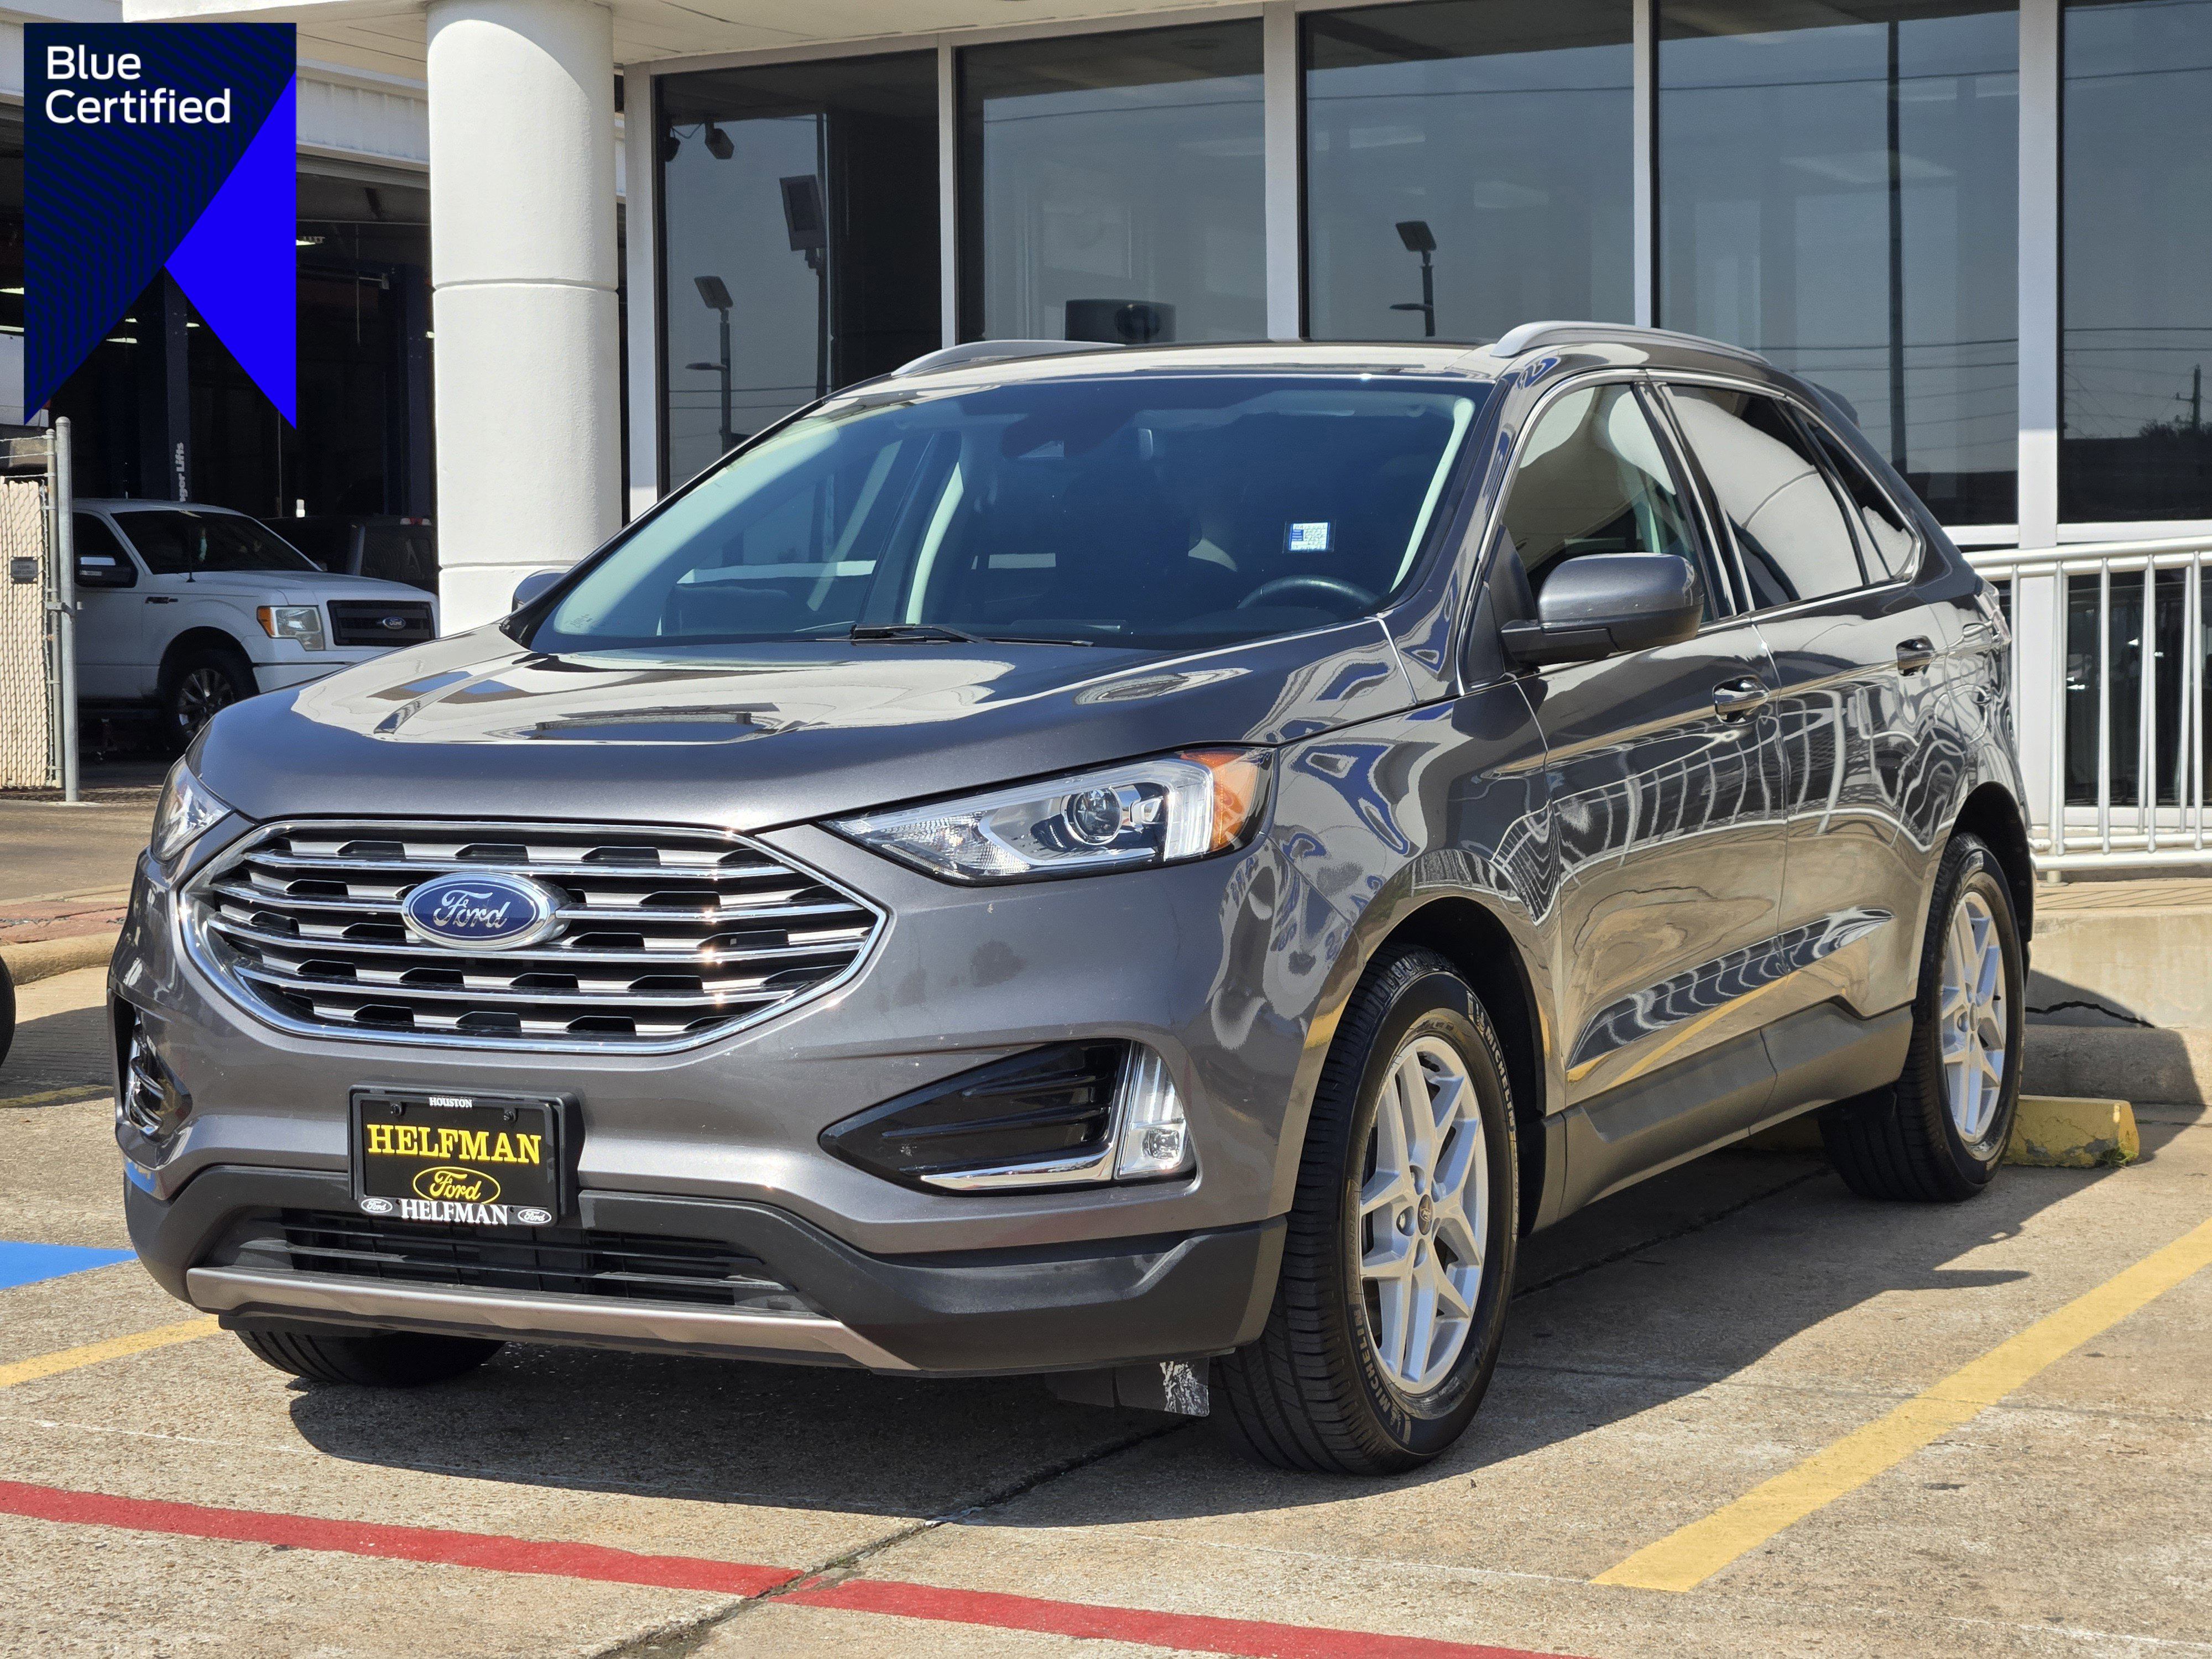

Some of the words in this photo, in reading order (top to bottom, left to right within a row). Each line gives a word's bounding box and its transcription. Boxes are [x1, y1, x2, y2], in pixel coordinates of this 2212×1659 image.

[175, 442, 185, 472] Lifts
[433, 889, 511, 928] Ford
[1485, 1026, 1516, 1127] MICHELIN
[429, 1097, 473, 1108] HOUSTON
[367, 1124, 542, 1164] HELFMAN
[429, 1170, 482, 1200] Ford
[366, 1199, 387, 1212] Ford
[399, 1198, 509, 1226] HELFMAN
[523, 1210, 546, 1223] Ford
[1353, 1309, 1391, 1413] MICHELIN
